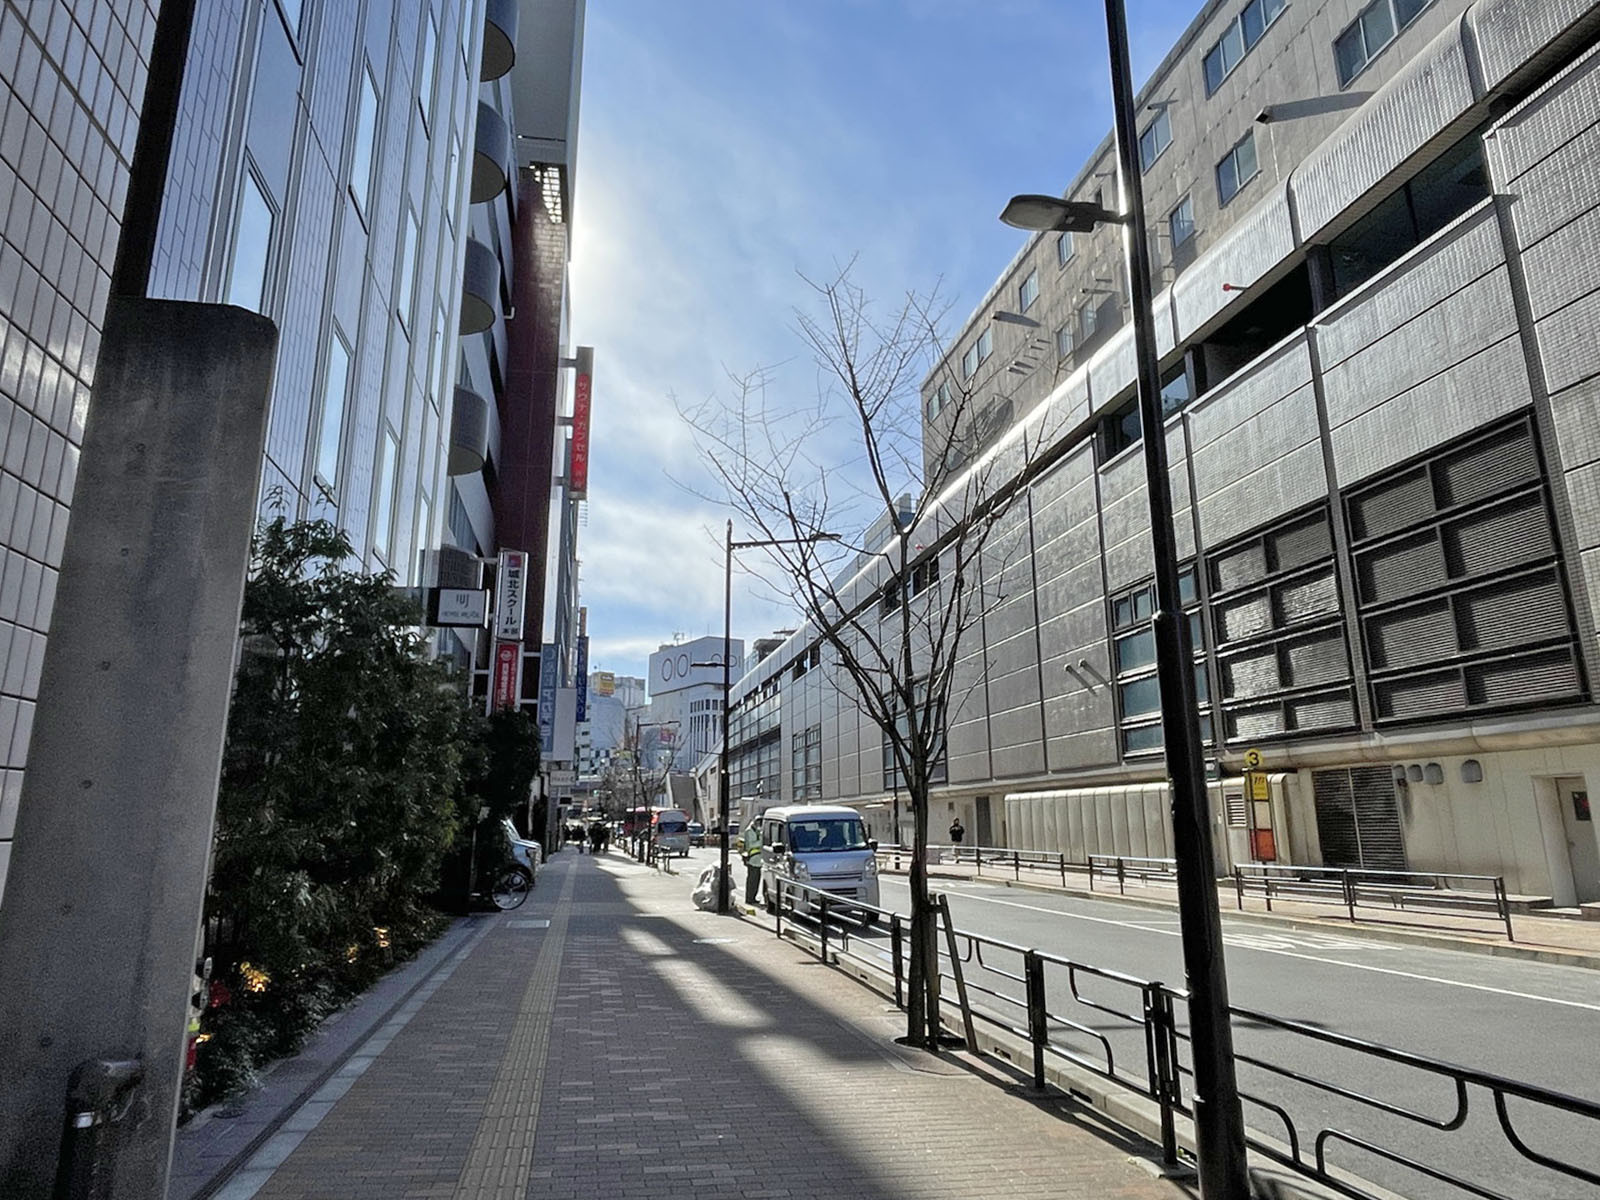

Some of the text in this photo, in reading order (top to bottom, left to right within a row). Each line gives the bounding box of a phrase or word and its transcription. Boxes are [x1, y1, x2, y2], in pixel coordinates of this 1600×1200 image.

[505, 570, 520, 625] 城北スクール
[1249, 752, 1260, 766] 3
